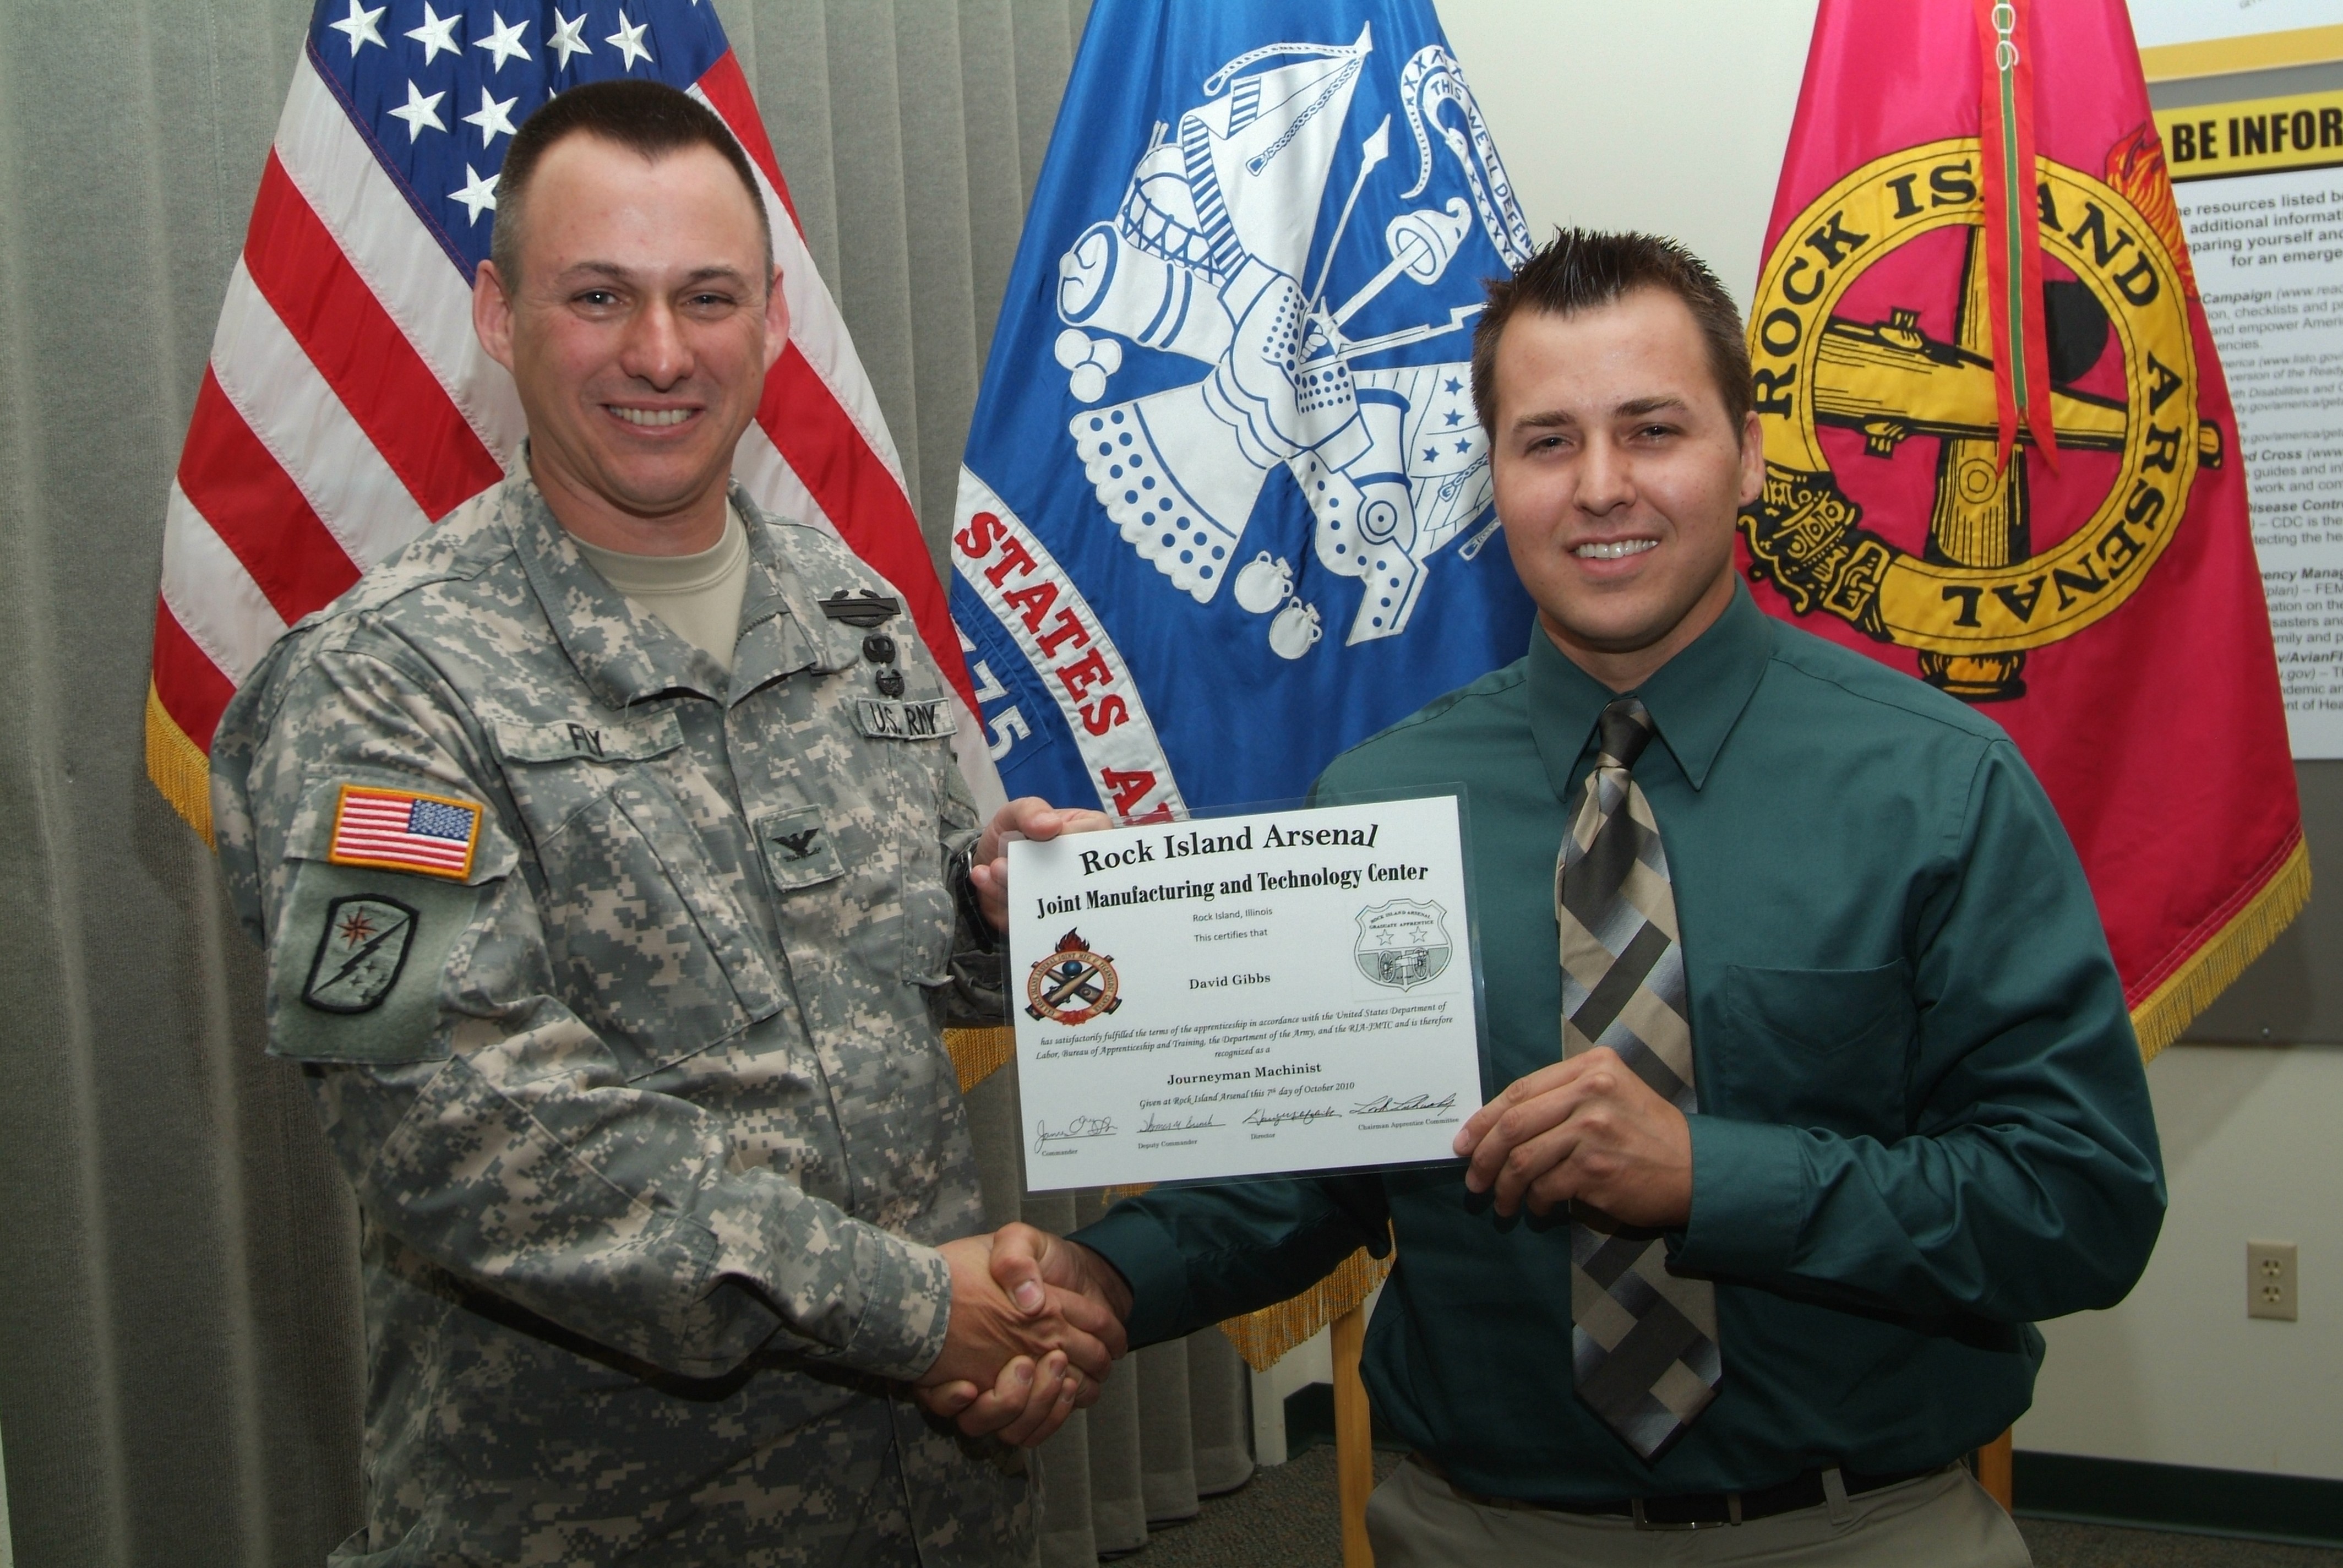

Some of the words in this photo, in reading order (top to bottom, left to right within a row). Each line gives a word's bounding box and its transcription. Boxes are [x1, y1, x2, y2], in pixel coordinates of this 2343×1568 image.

[1431, 79, 1462, 101] THIS
[1468, 107, 1498, 178] WE'LL
[2172, 120, 2218, 163] BE
[2197, 198, 2276, 215] resources
[2281, 191, 2326, 206] listed
[2191, 215, 2269, 234] additional
[2248, 229, 2314, 249] yourself
[2232, 254, 2253, 267] for
[2259, 254, 2277, 265] an
[2203, 289, 2271, 304] Campaign
[2235, 302, 2298, 318] checklists
[2303, 300, 2328, 313] and
[2239, 320, 2298, 335] empower
[1752, 210, 1870, 420] ROCK
[1942, 351, 2182, 628] ARSENAL
[2262, 449, 2302, 461] Cross
[2254, 466, 2297, 480] guides
[2302, 464, 2326, 475] and
[2254, 481, 2284, 493] work
[2290, 481, 2314, 492] and
[2272, 515, 2302, 529] CDC
[2308, 516, 2318, 526] is
[2302, 532, 2322, 542] the
[954, 511, 1130, 736] STATES
[2307, 631, 2331, 643] and
[2303, 699, 2315, 710] of
[1078, 840, 1156, 875] Rock
[1164, 826, 1253, 859] Island
[1263, 824, 1378, 848] Arsenal
[1037, 894, 1082, 919] Joint
[1086, 880, 1215, 910] Manufacturing
[1220, 873, 1253, 895] and
[1257, 867, 1363, 891] Technology
[1368, 863, 1429, 881] Center
[1193, 913, 1213, 922] Rock
[1216, 910, 1243, 920] Island,
[1245, 907, 1273, 917] Illinois
[1194, 934, 1211, 942] This
[1214, 930, 1247, 940] certifies
[1250, 929, 1268, 937] that
[1189, 976, 1228, 989] David
[1233, 973, 1271, 985] Gibbs
[1040, 1037, 1053, 1046] has
[1055, 1032, 1103, 1046] satisfactorily
[1103, 1029, 1134, 1042] fulfilled
[1135, 1028, 1147, 1037] the
[1149, 1027, 1168, 1036] terms
[1170, 1025, 1179, 1037] of
[1181, 1024, 1192, 1033] the
[1194, 1020, 1247, 1035] apprenticeship
[1250, 1020, 1257, 1028] in
[1259, 1016, 1299, 1026] accordance
[1301, 1013, 1319, 1023] with
[1321, 1012, 1333, 1021] the
[1335, 1009, 1363, 1020] United
[1364, 1008, 1388, 1017] States
[1390, 1004, 1436, 1016] Department
[1438, 1001, 1448, 1012] of
[1036, 1050, 1060, 1060] Labor,
[1062, 1048, 1089, 1057] Bureau
[1091, 1046, 1100, 1058] of
[1100, 1039, 1155, 1055] Apprenticeship
[1156, 1039, 1170, 1049] and
[1172, 1037, 1206, 1048] Training,
[1209, 1036, 1220, 1045] the
[1221, 1031, 1267, 1046] Department
[1269, 1030, 1278, 1041] of
[1279, 1028, 1291, 1038] the
[1292, 1027, 1316, 1039] Army,
[1318, 1026, 1333, 1035] and
[1335, 1023, 1347, 1033] the
[1348, 1020, 1393, 1033] RIA-JMTC
[1394, 1019, 1409, 1028] and
[1411, 1018, 1418, 1027] is
[1420, 1015, 1453, 1026] therefore
[1215, 1047, 1254, 1059] recognized
[1167, 1071, 1251, 1085] Journeyman
[1255, 1063, 1322, 1078] Machinist
[1140, 1099, 1161, 1110] Given
[1173, 1096, 1195, 1106] Rock
[1194, 1093, 1218, 1104] Island
[1219, 1091, 1249, 1101] Arsenal
[1250, 1090, 1265, 1098] this
[1279, 1086, 1293, 1097] day
[1294, 1085, 1304, 1096] of
[1305, 1083, 1334, 1093] October
[1336, 1082, 1355, 1091] 2010
[1391, 1120, 1424, 1130] Apprentice
[1425, 1117, 1459, 1125] Committee
[1251, 1132, 1275, 1140] Director
[1138, 1141, 1159, 1150] Deputy
[1161, 1139, 1197, 1147] Commander
